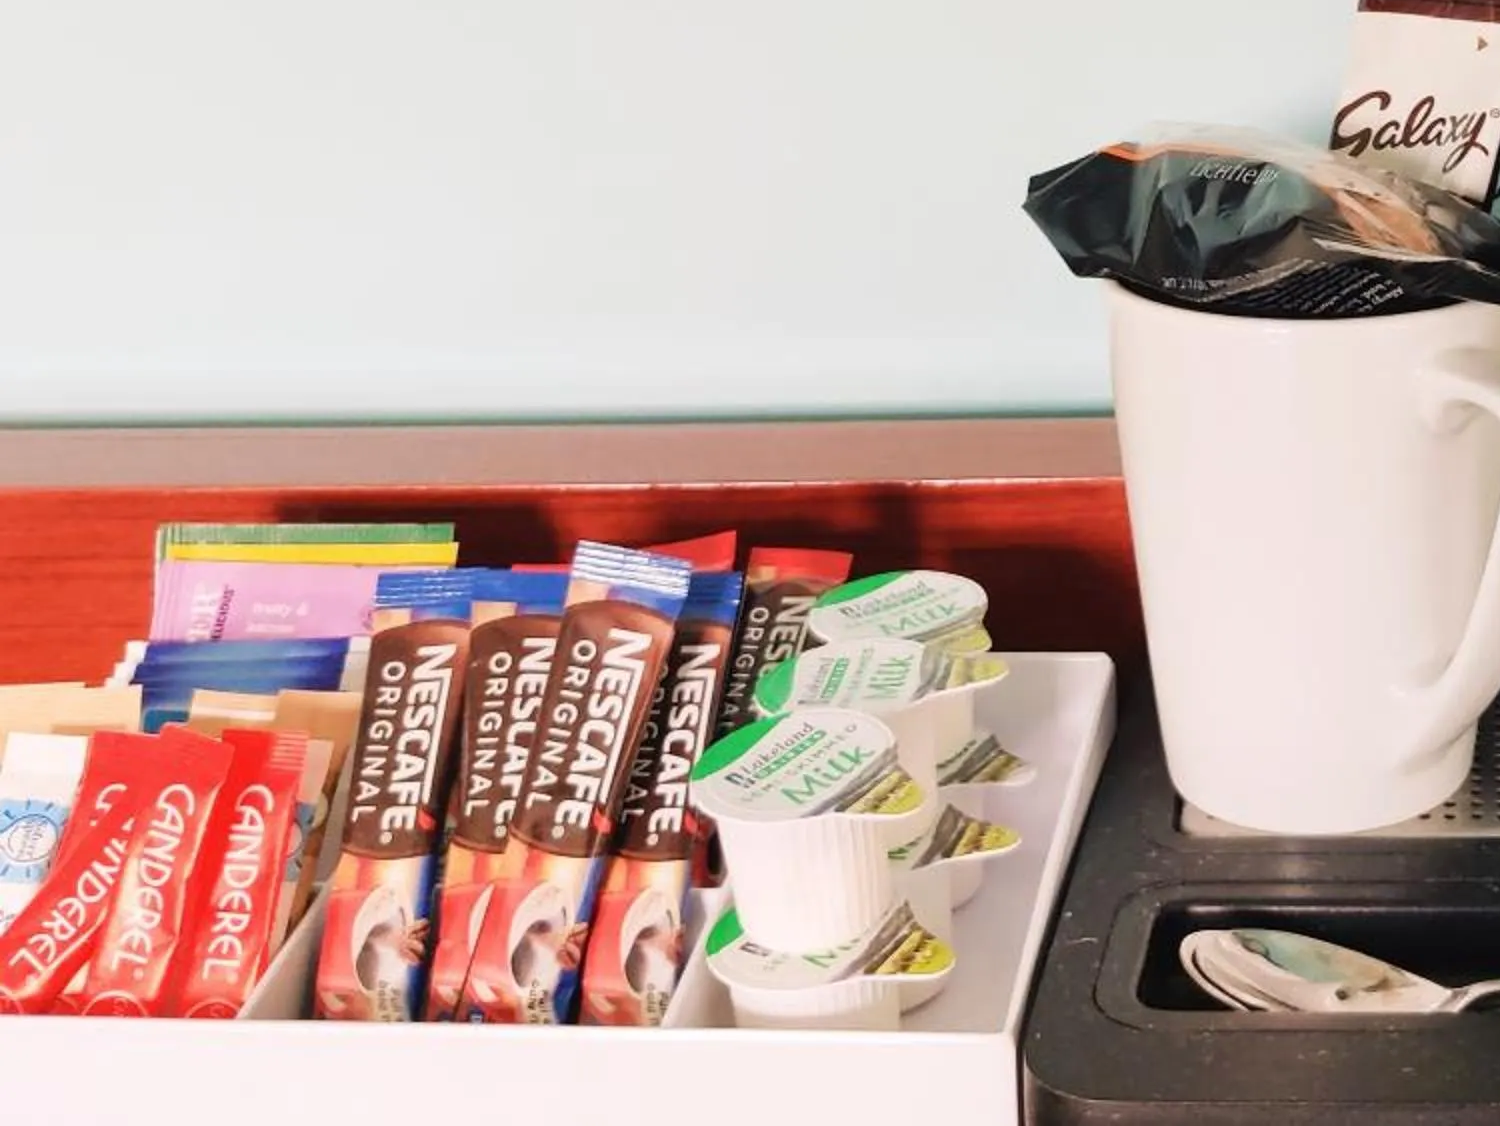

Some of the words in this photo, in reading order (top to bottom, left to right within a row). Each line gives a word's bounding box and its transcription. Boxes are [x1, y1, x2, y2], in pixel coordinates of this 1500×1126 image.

[1330, 90, 1490, 173] Galaxy
[351, 660, 407, 824] ORIGINAL
[464, 651, 513, 817] ORIGINAL
[524, 639, 597, 811] ORIGINAL
[780, 744, 876, 805] Milk
[8, 783, 136, 975] CNDEREL
[110, 783, 196, 971] CANDEREL
[201, 783, 275, 980] CANDEREL
